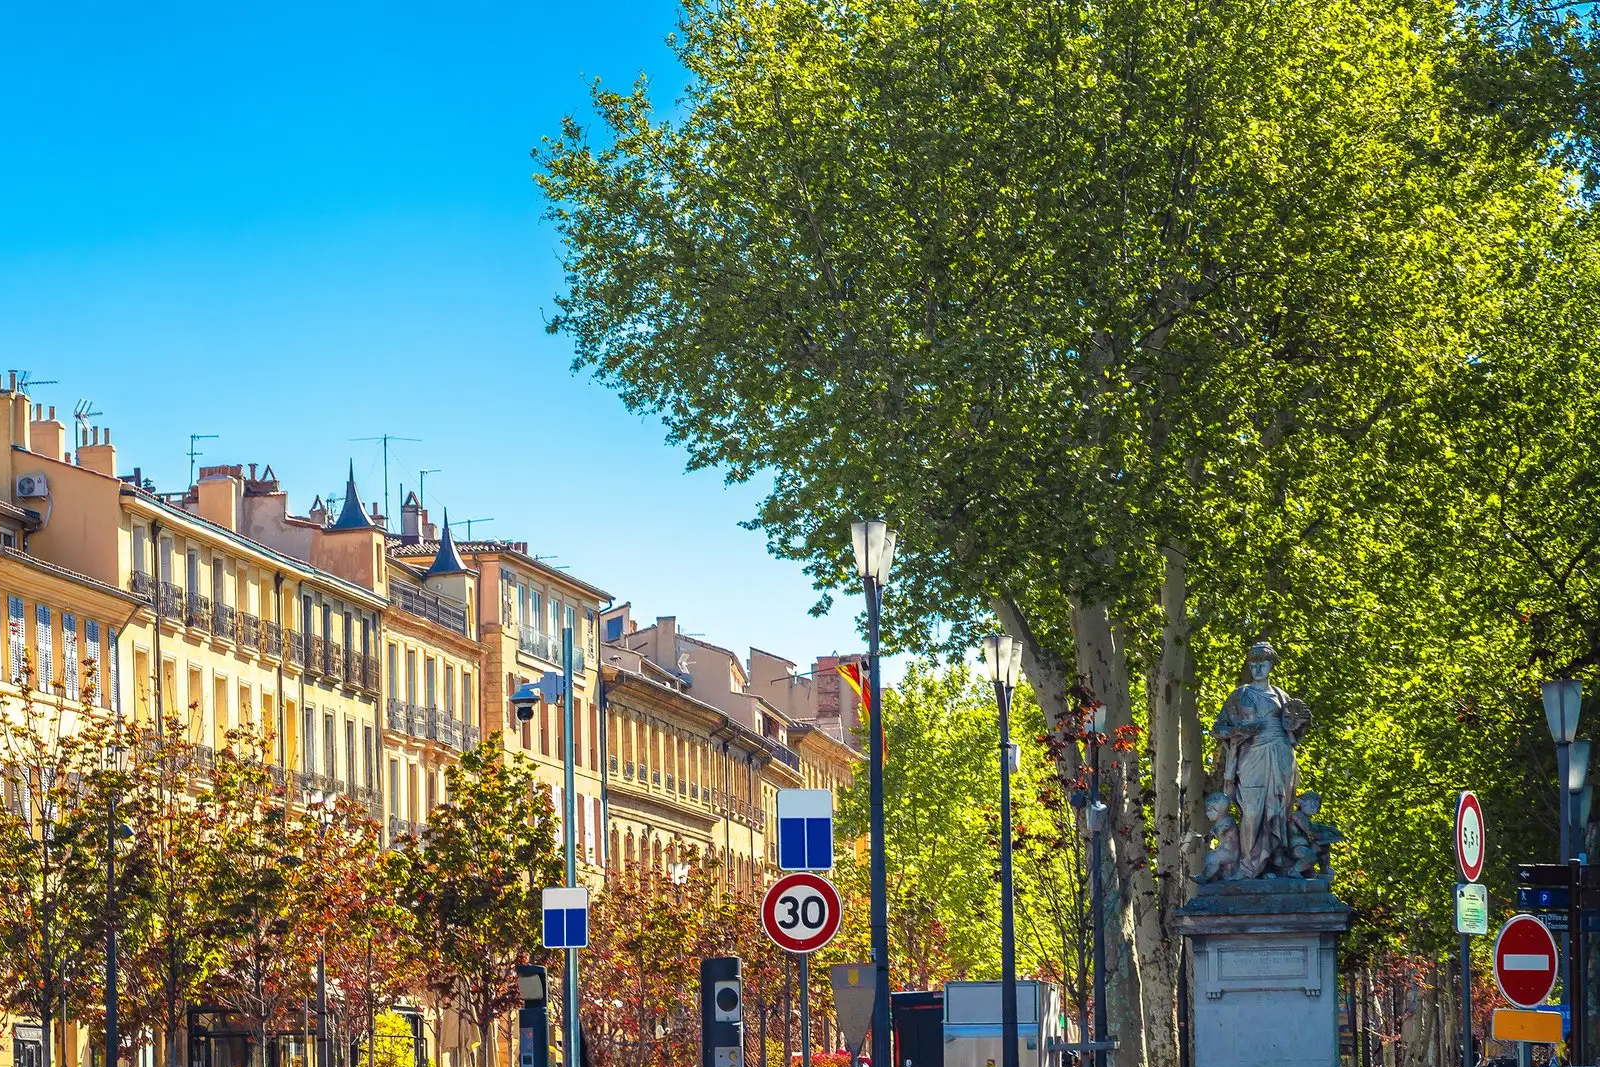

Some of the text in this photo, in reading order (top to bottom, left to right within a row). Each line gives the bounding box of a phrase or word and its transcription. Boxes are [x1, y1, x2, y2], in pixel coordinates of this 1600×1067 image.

[1463, 827, 1475, 849] 5,5
[1542, 893, 1548, 903] P
[778, 895, 825, 929] 30
